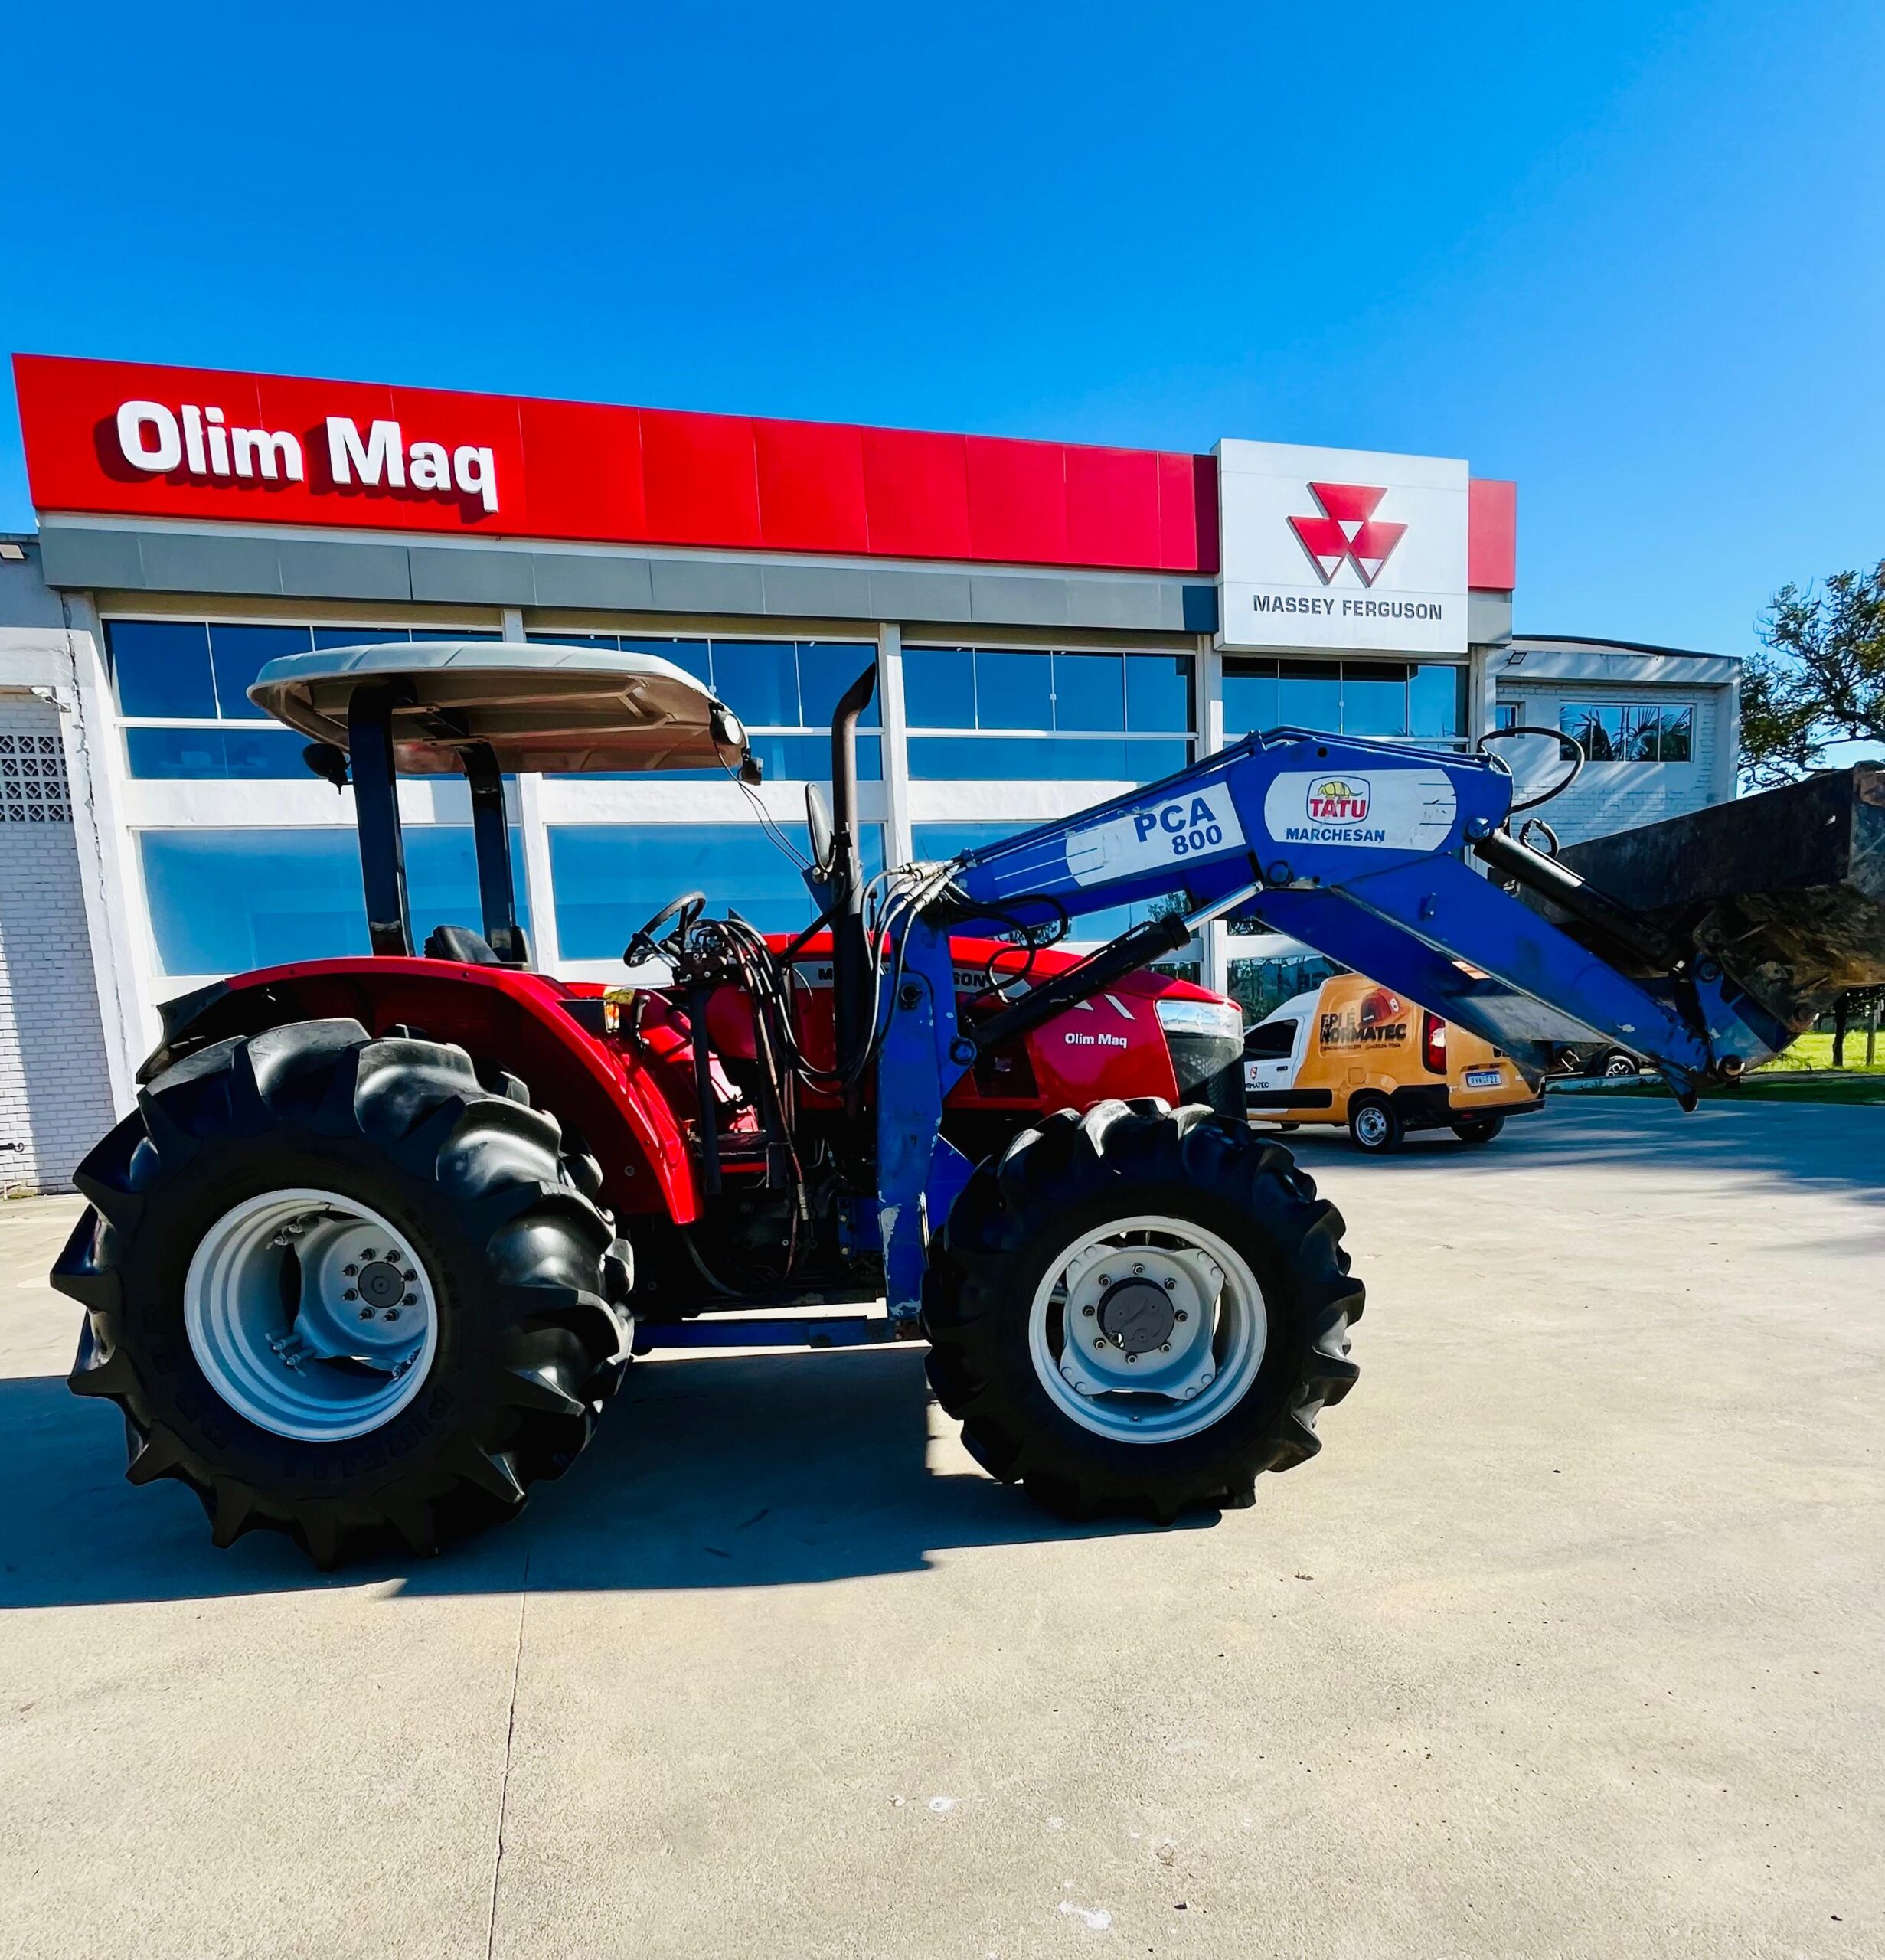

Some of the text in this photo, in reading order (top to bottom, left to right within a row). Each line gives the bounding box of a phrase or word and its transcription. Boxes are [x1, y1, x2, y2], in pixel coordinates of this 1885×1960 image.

[116, 400, 499, 513] Olim Maq
[1253, 594, 1442, 620] MASSEY FERGUSON
[1134, 797, 1216, 842] PCA
[1309, 799, 1366, 818] TATU
[1171, 825, 1223, 855] 800
[1286, 828, 1385, 842] MARCHESAN
[1065, 1033, 1127, 1049] Olim Maq
[1321, 1023, 1407, 1044] NORMATEC
